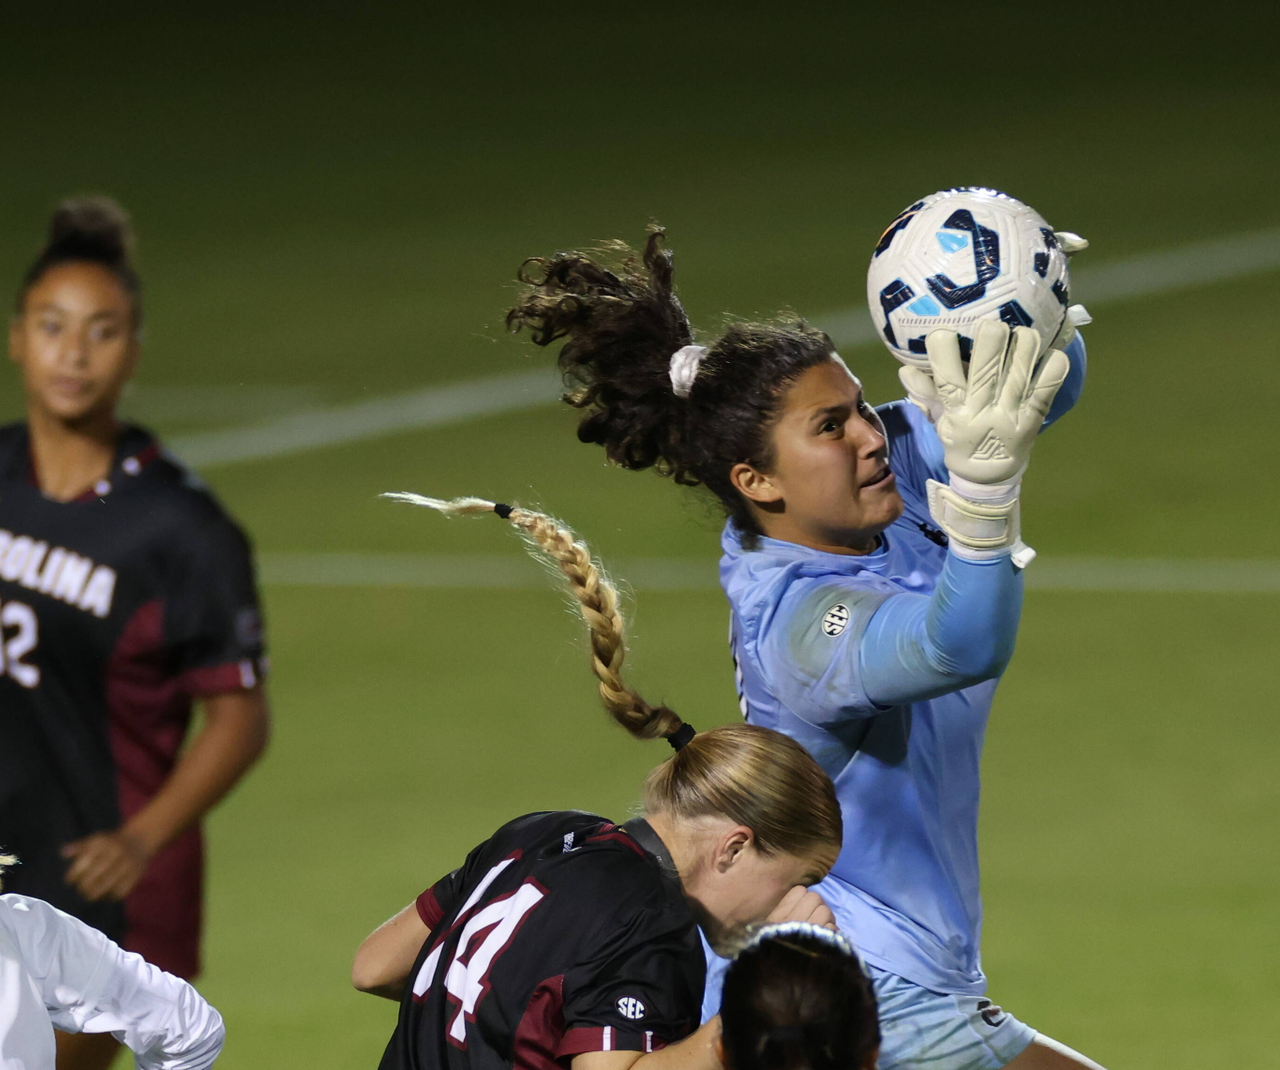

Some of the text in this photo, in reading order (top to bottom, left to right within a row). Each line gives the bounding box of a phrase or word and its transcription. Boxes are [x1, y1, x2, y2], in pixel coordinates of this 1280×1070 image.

[823, 605, 849, 636] SEC
[412, 855, 547, 1045] 14
[617, 996, 646, 1019] SEC
